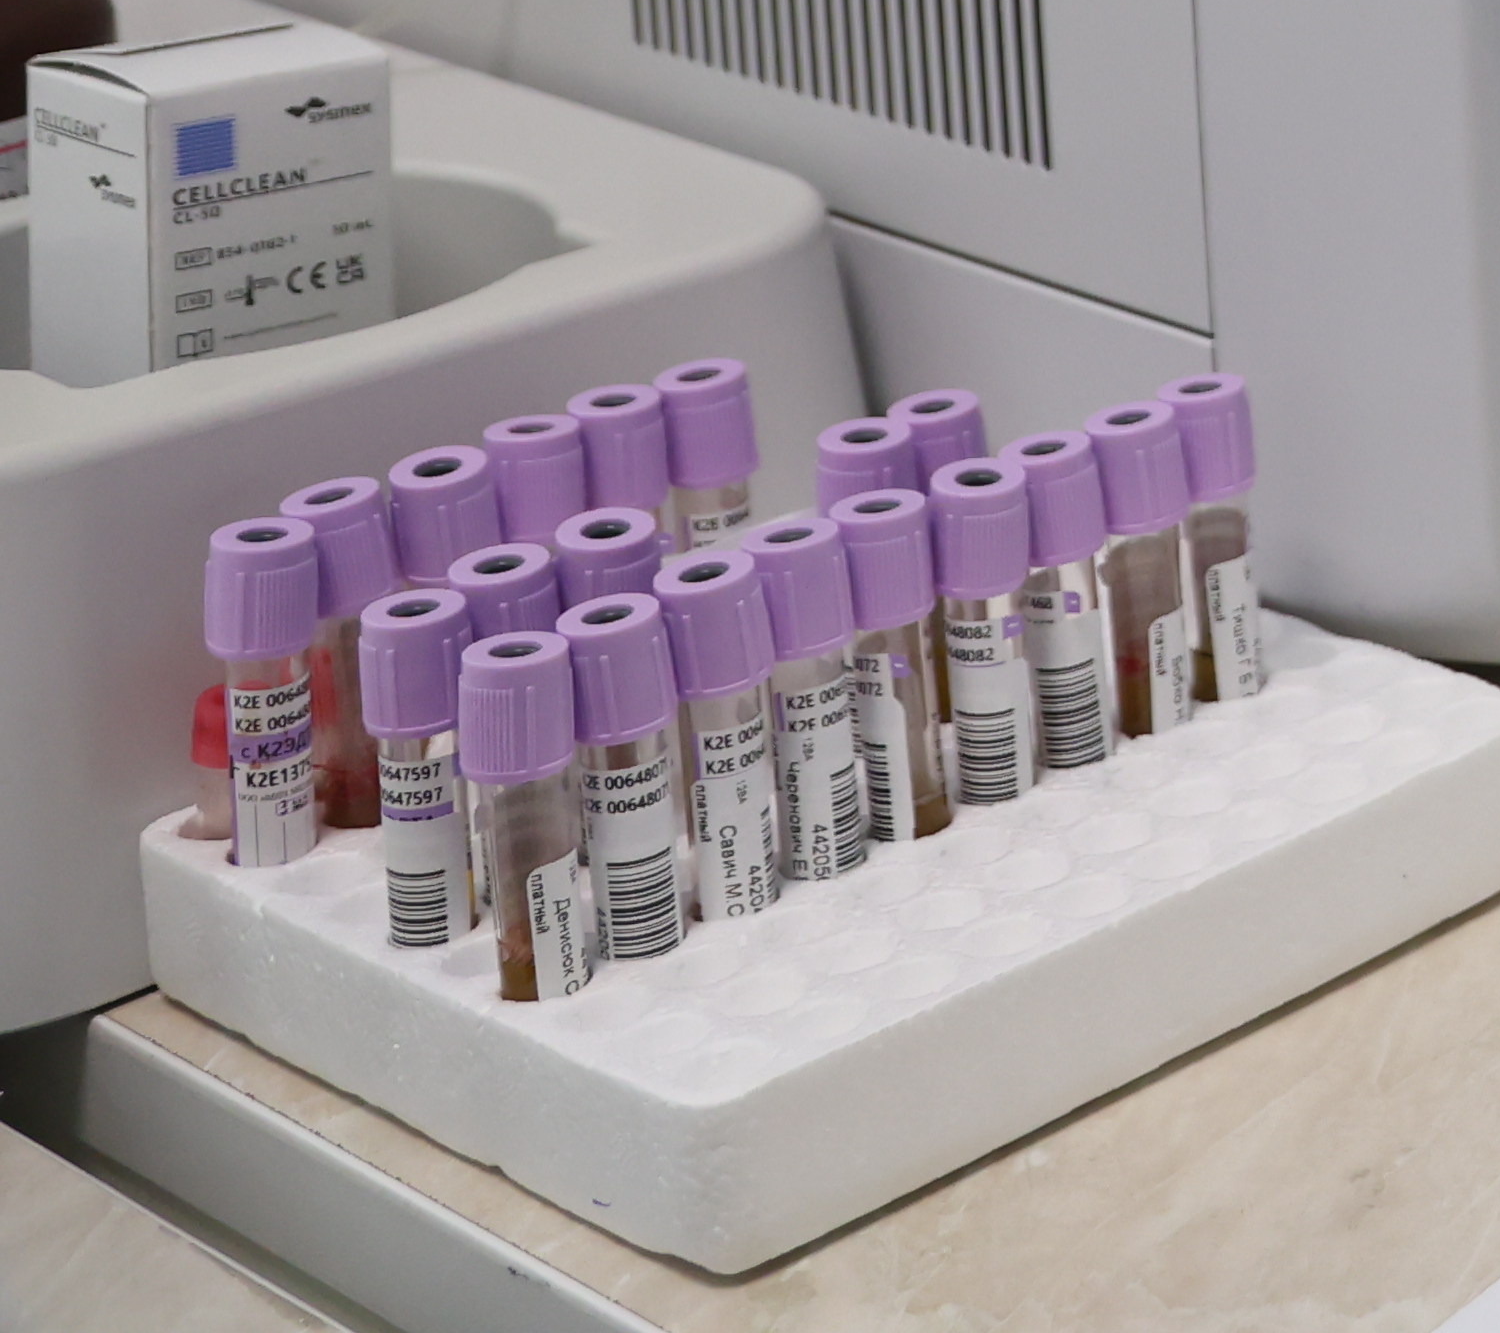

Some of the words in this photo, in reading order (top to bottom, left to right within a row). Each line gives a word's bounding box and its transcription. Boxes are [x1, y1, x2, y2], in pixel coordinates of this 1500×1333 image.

[307, 102, 373, 124] sysmex
[172, 167, 308, 208] CELLCLEAN
[233, 694, 261, 710] K2E
[785, 692, 816, 711] K2E
[235, 717, 262, 733] K2E
[702, 733, 734, 751] K2E
[704, 756, 736, 776] K2E
[695, 784, 713, 844] платный
[718, 824, 738, 879] Савич
[811, 823, 832, 882] 44205
[530, 873, 551, 935] платный
[552, 897, 575, 979] Денисюк
